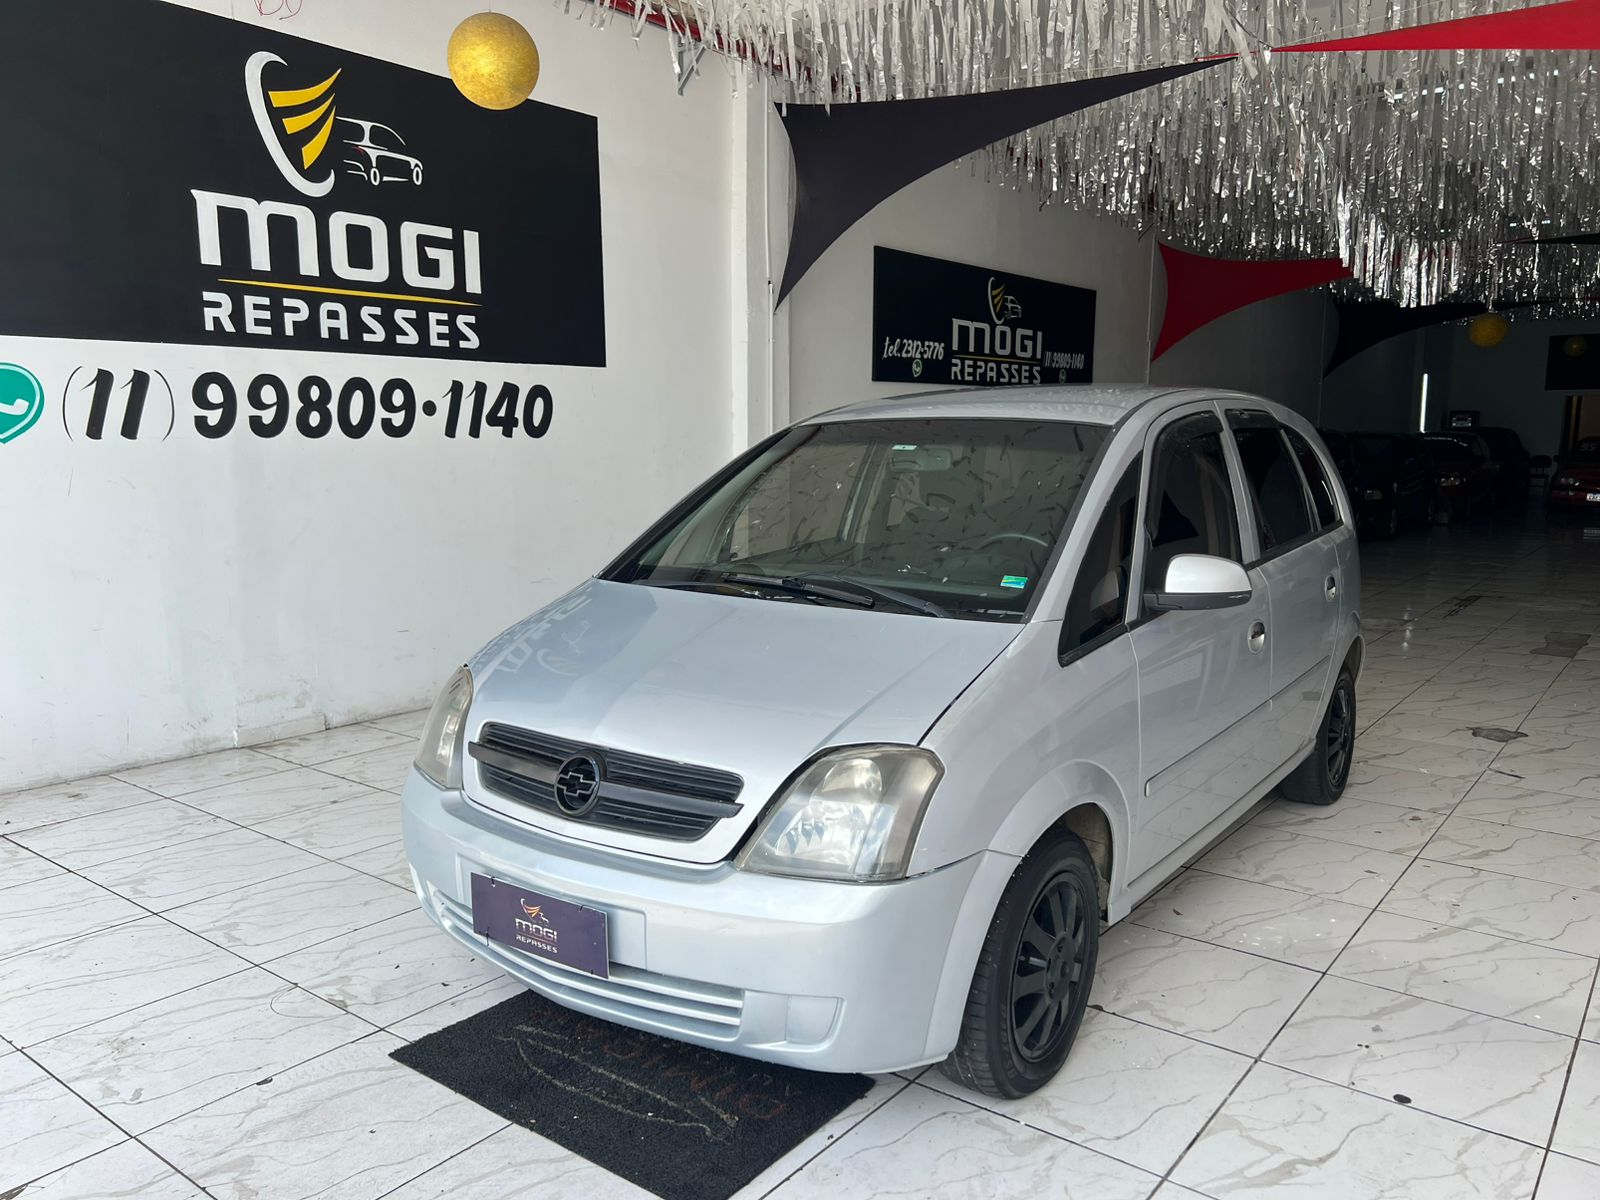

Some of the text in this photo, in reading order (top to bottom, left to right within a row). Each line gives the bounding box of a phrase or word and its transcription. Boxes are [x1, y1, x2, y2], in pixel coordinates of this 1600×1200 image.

[190, 189, 482, 293] MOGI
[202, 291, 480, 349] REPASSES
[951, 318, 1043, 359] MOGI
[951, 358, 1041, 385] REPASSES
[62, 366, 175, 442] (11)
[515, 918, 558, 942] MOGI
[516, 934, 558, 953] REPASSES
